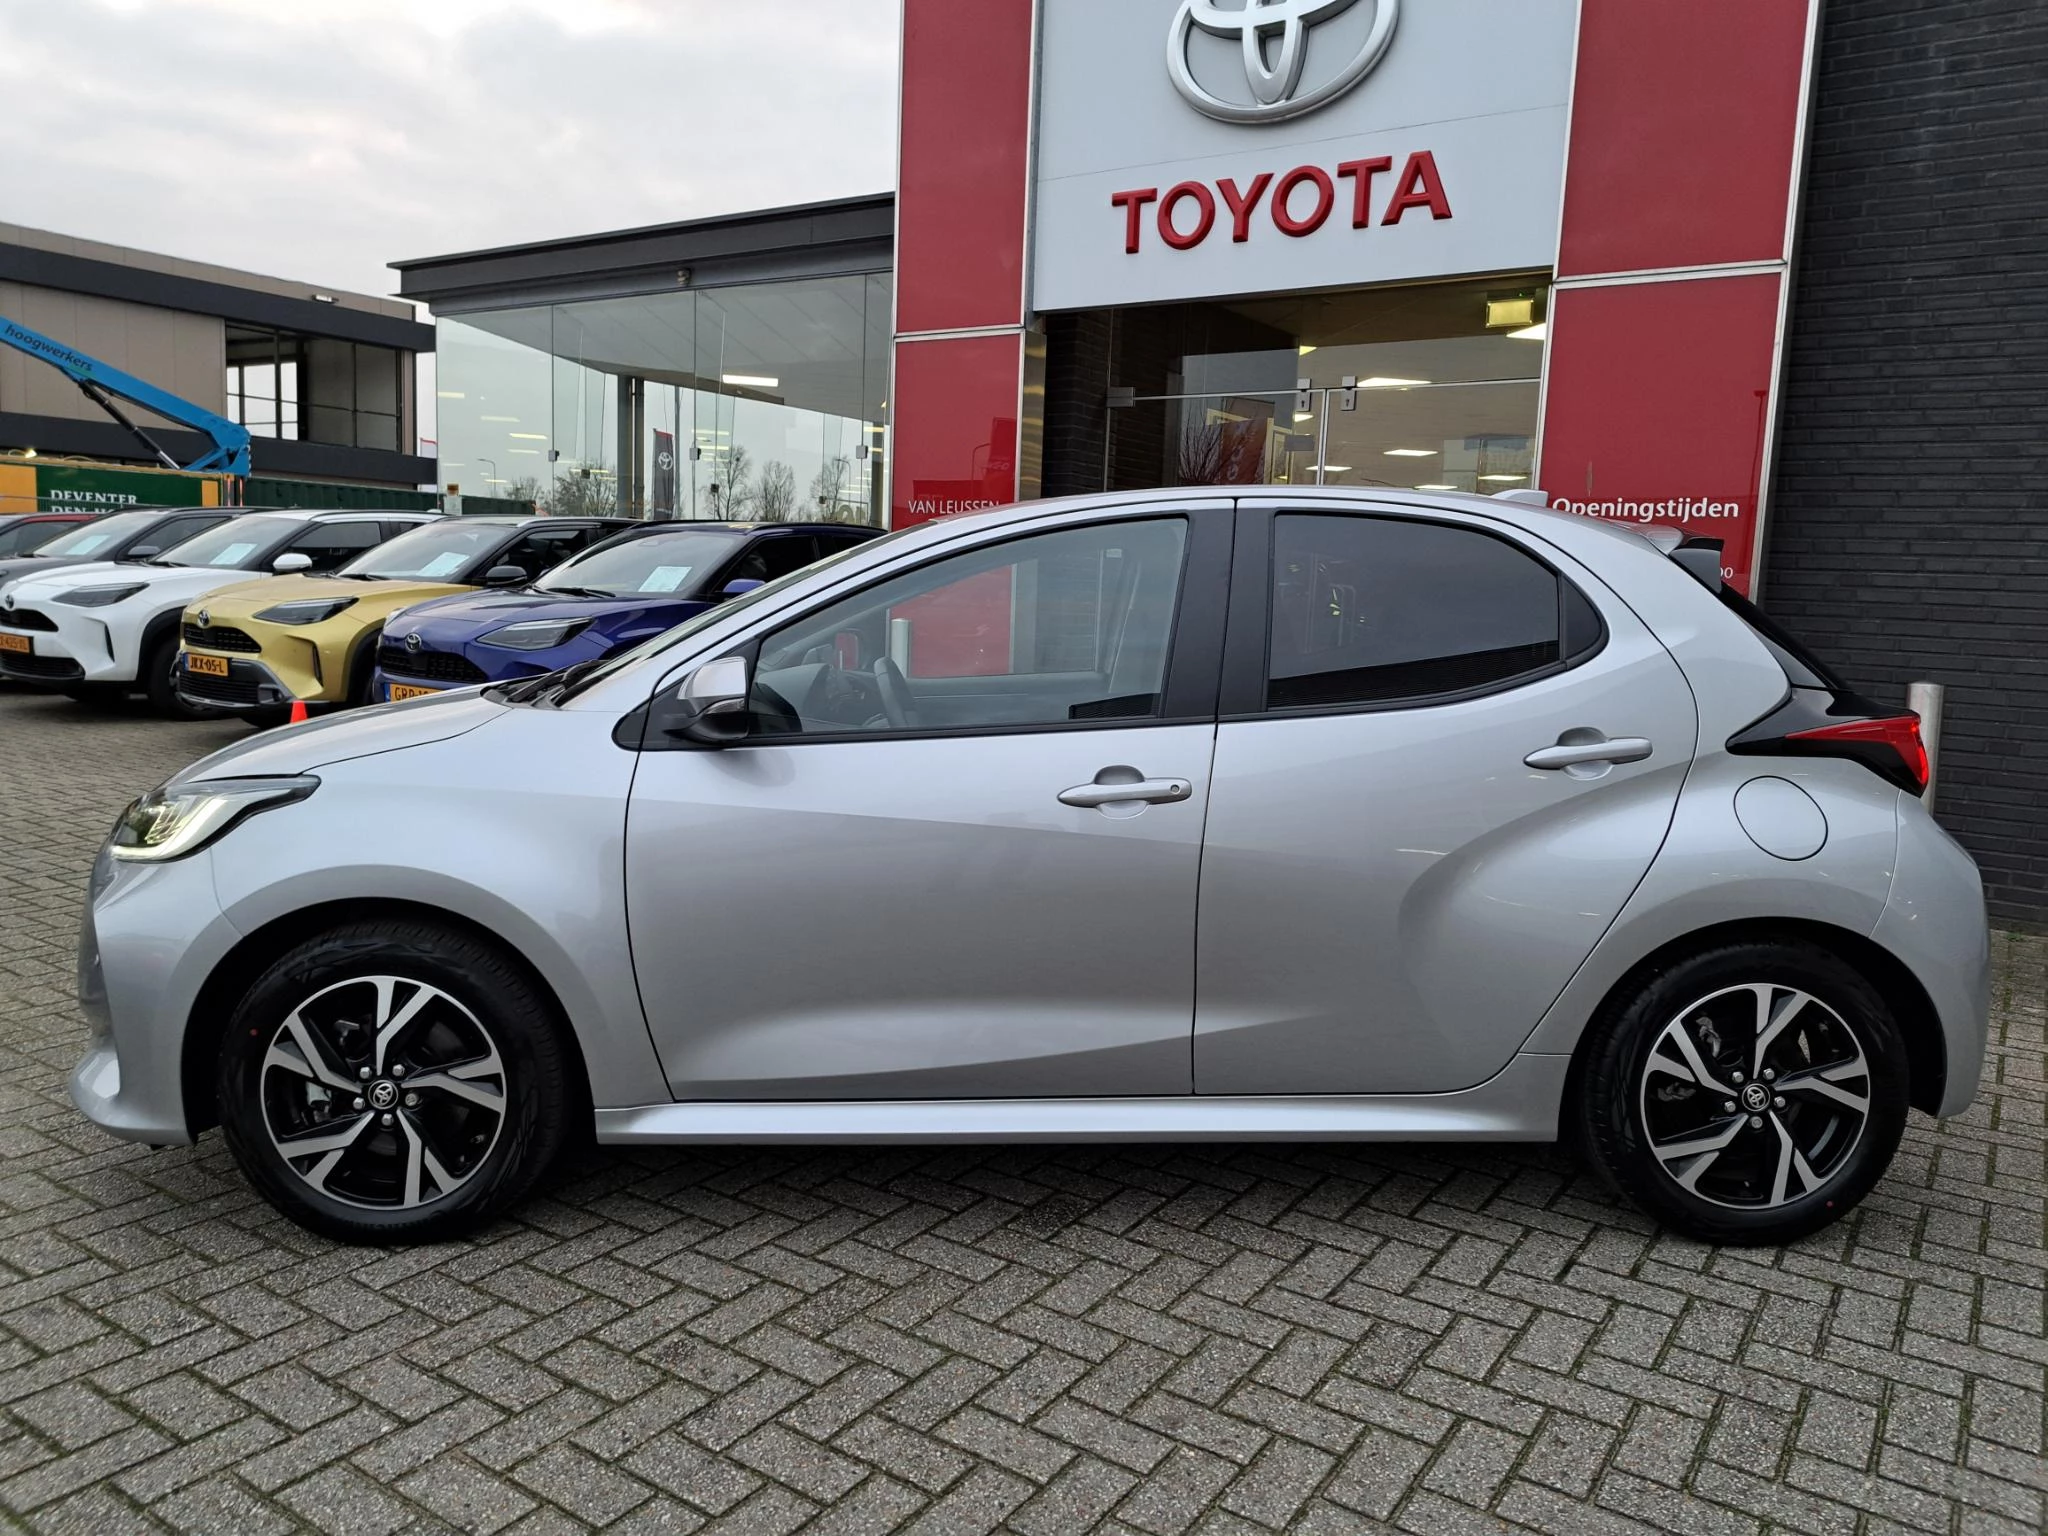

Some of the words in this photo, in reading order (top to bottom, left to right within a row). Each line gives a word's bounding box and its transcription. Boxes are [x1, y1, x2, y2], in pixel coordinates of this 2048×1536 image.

[1112, 150, 1453, 254] TOYOTA
[5, 324, 93, 371] hoogwerkers
[51, 490, 137, 504] DEVENTER
[908, 500, 936, 514] VAN
[1552, 497, 1739, 523] Openingstijden
